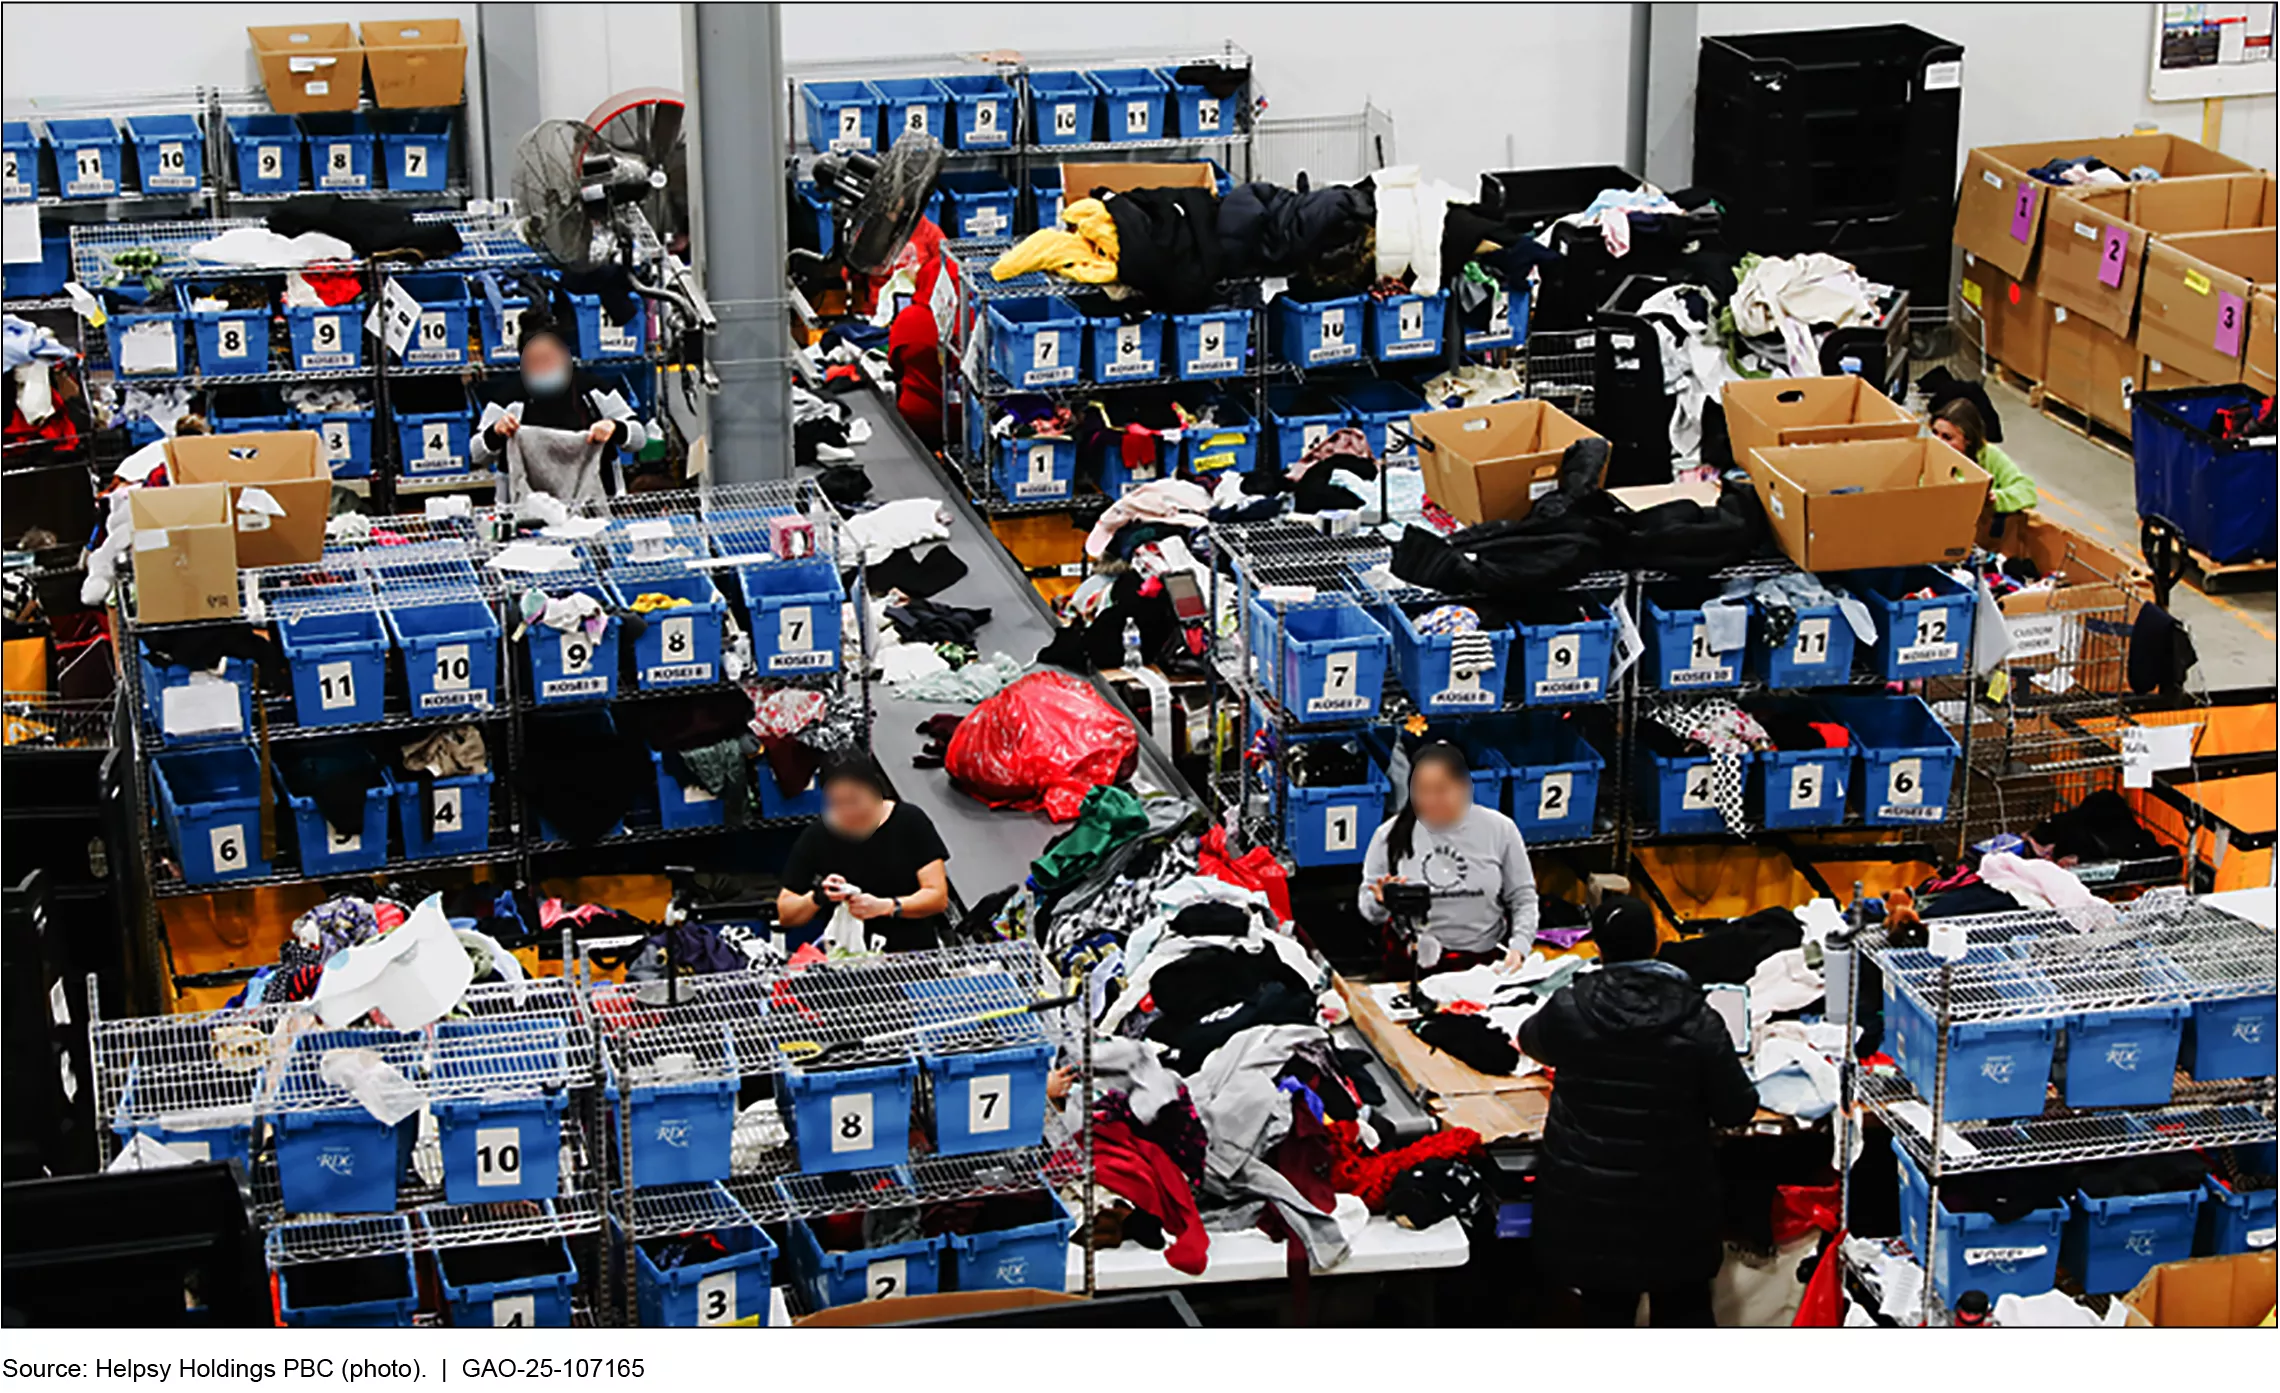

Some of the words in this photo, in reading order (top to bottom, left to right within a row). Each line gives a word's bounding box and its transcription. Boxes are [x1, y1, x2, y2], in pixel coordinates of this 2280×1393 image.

[845, 117, 856, 131] 7
[911, 114, 923, 129] 8
[980, 109, 992, 125] 9
[1056, 114, 1076, 129] 10
[1128, 111, 1146, 127] 11
[1200, 108, 1220, 123] 12
[78, 158, 101, 175] 11
[161, 151, 184, 168] 10
[262, 155, 276, 172] 9
[333, 153, 347, 169] 8
[408, 154, 422, 172] 7
[2018, 196, 2029, 219] 1
[2109, 239, 2120, 262] 2
[2224, 306, 2235, 329] 3
[224, 330, 240, 351] 8
[319, 324, 336, 345] 9
[422, 323, 446, 340] 10
[1040, 342, 1052, 360] 7
[1121, 335, 1135, 354] 8
[330, 433, 343, 451] 3
[428, 434, 443, 451] 4
[1035, 456, 1045, 473] 1
[667, 628, 685, 653] 8
[788, 621, 804, 641] 7
[1917, 621, 1947, 644] 12
[1798, 631, 1827, 653] 11
[567, 643, 587, 668] 9
[774, 655, 815, 666] KOSEI
[817, 654, 825, 664] 7
[1555, 647, 1571, 667] 9
[437, 658, 469, 680] 10
[654, 668, 692, 679] KOSEI
[1333, 666, 1349, 687] 7
[1673, 672, 1711, 683] KOSEI
[320, 674, 352, 700] 11
[549, 681, 588, 693] KOSEI
[591, 680, 599, 690] 9
[1542, 682, 1581, 693] KOSEI
[424, 694, 466, 706] KOSEI
[1313, 699, 1352, 709] KOSEI
[1437, 692, 1476, 702] KOSEI
[1690, 778, 1709, 801] 4
[1798, 778, 1813, 799] 5
[1895, 770, 1913, 793] 6
[1545, 785, 1563, 809] 2
[434, 802, 455, 824] 4
[1333, 818, 1348, 842] 1
[220, 839, 238, 861] 6
[979, 1092, 999, 1120] 7
[841, 1112, 862, 1139] 8
[476, 1144, 520, 1174] 10
[875, 1277, 897, 1300] 2
[706, 1290, 727, 1319] 3
